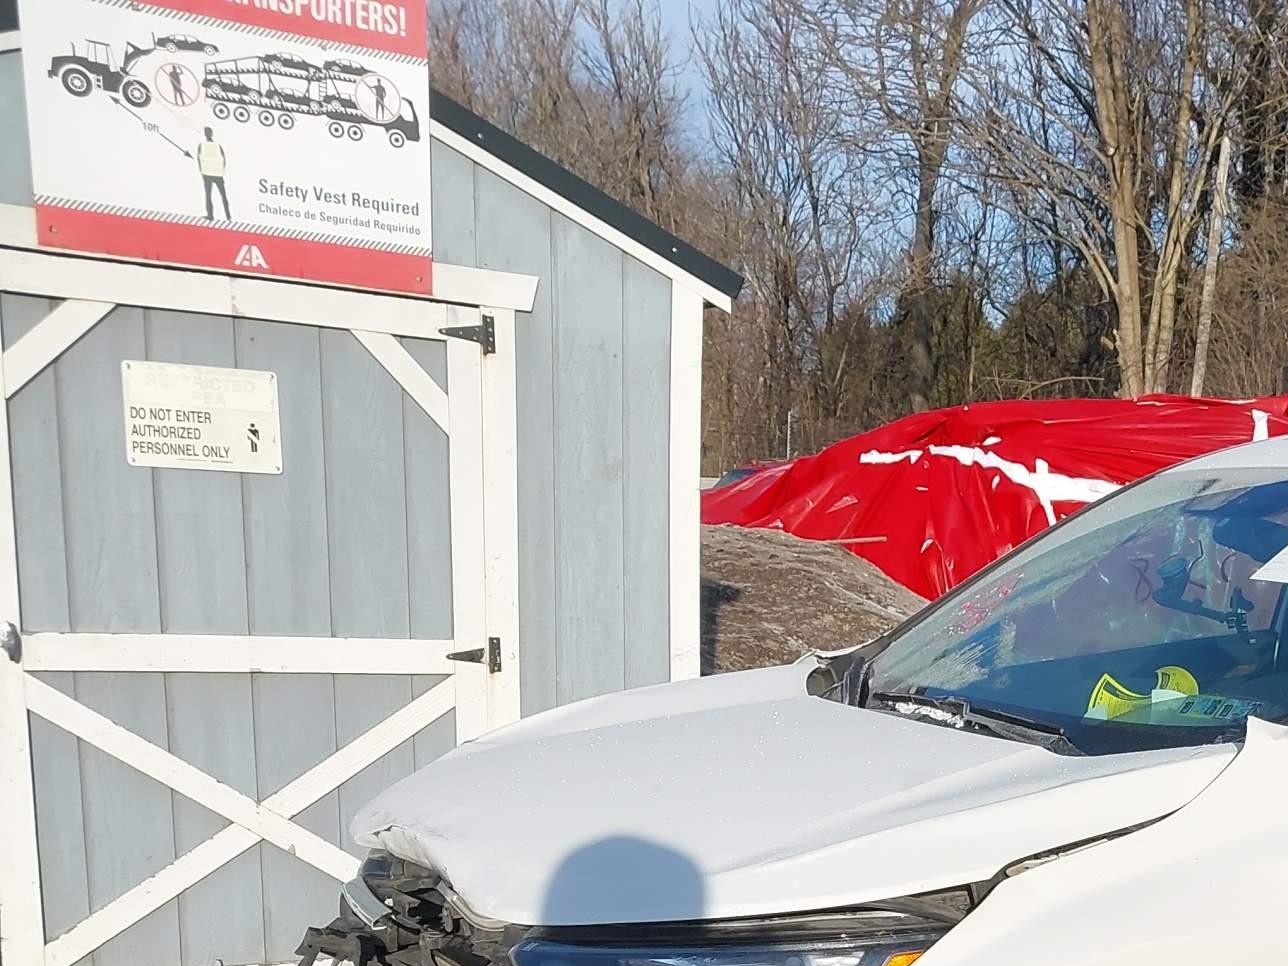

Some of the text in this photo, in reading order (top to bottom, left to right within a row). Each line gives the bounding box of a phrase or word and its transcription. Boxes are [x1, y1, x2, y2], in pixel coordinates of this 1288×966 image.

[258, 178, 421, 217] Safety Vest Required
[258, 203, 421, 236] Chaleco de Seguridad Requirido
[129, 406, 212, 425] DO NOT ENTER
[131, 423, 201, 440] AUTHORIZED
[132, 440, 231, 459] PERSONNEL ONLY
